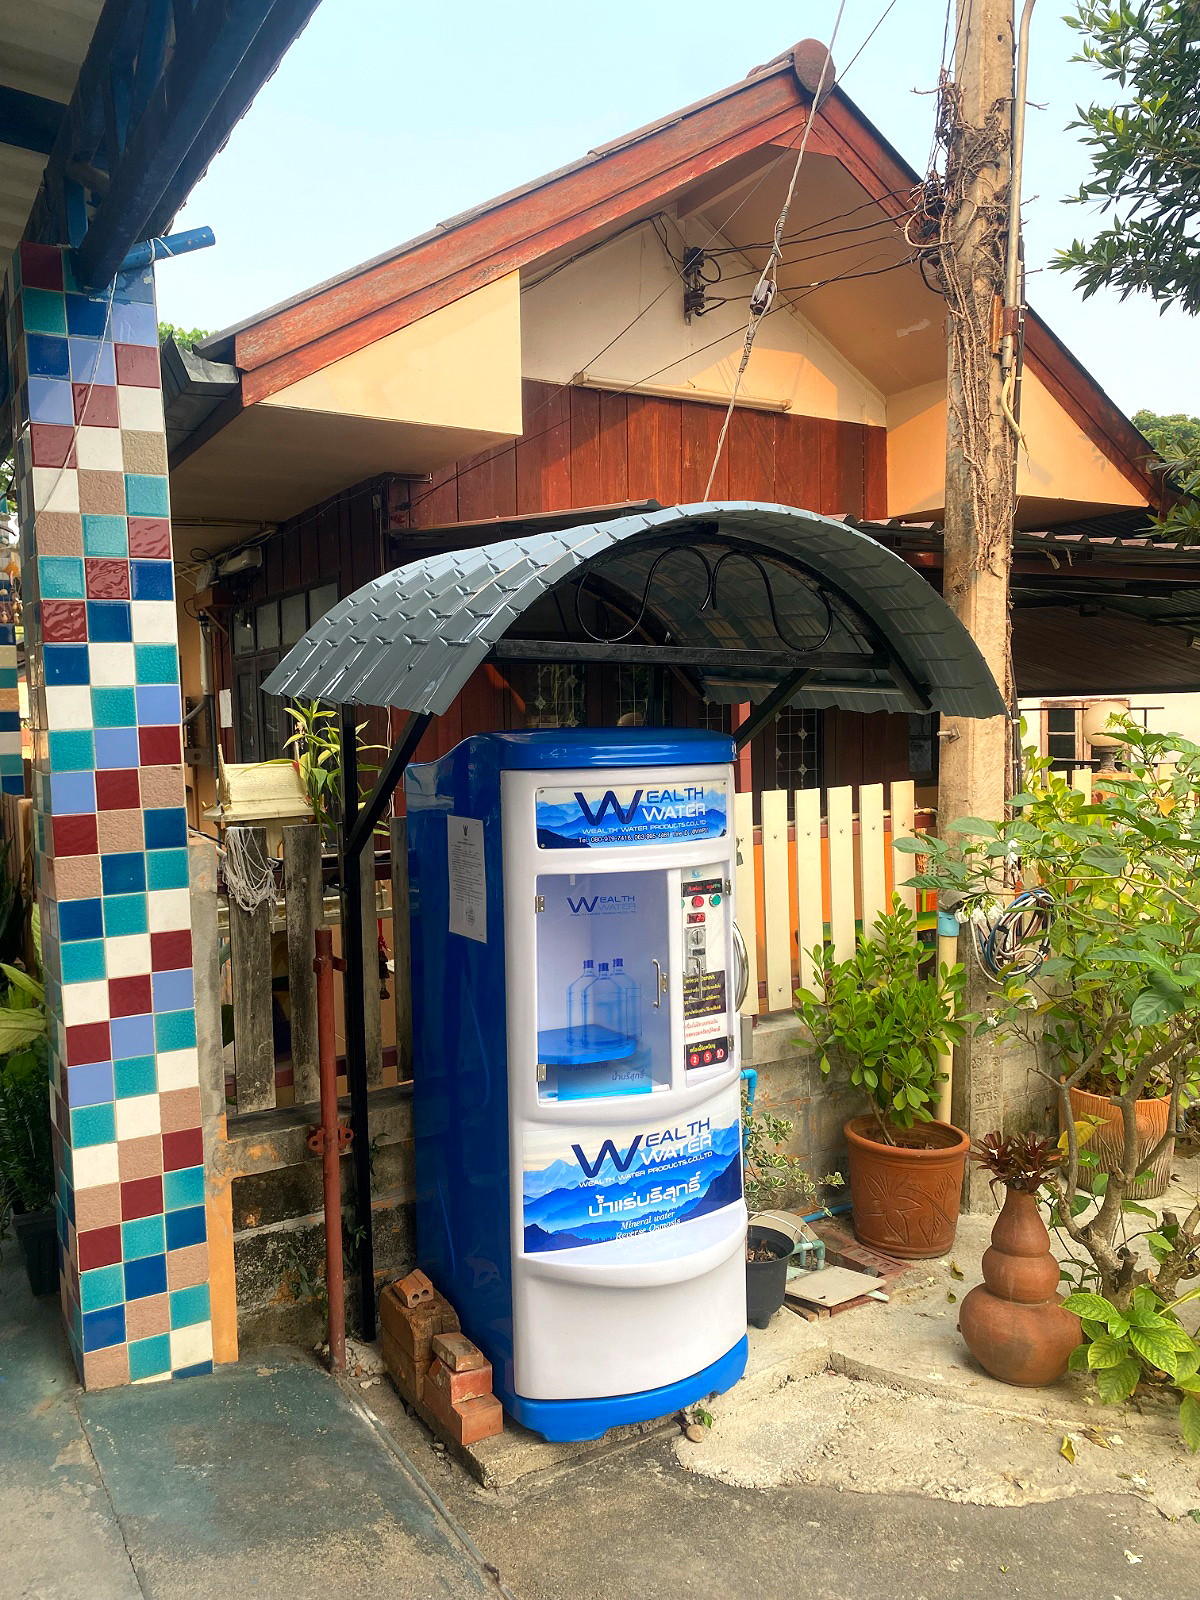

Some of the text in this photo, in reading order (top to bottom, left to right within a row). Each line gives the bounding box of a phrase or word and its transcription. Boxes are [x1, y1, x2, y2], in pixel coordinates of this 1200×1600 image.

[642, 802, 706, 821] WATER
[582, 827, 618, 835] WEALTH
[621, 825, 648, 833] WATER
[598, 902, 637, 911] WATER
[716, 1048, 724, 1060] 10
[640, 1134, 712, 1166] WATER
[579, 1177, 615, 1188] WEALTH
[618, 1170, 646, 1181] WATER
[588, 1171, 701, 1217] น้ำแร่บริสุทธิ์
[616, 1218, 682, 1240] Reverse Osmosis
[620, 1211, 676, 1231] Mineral water
